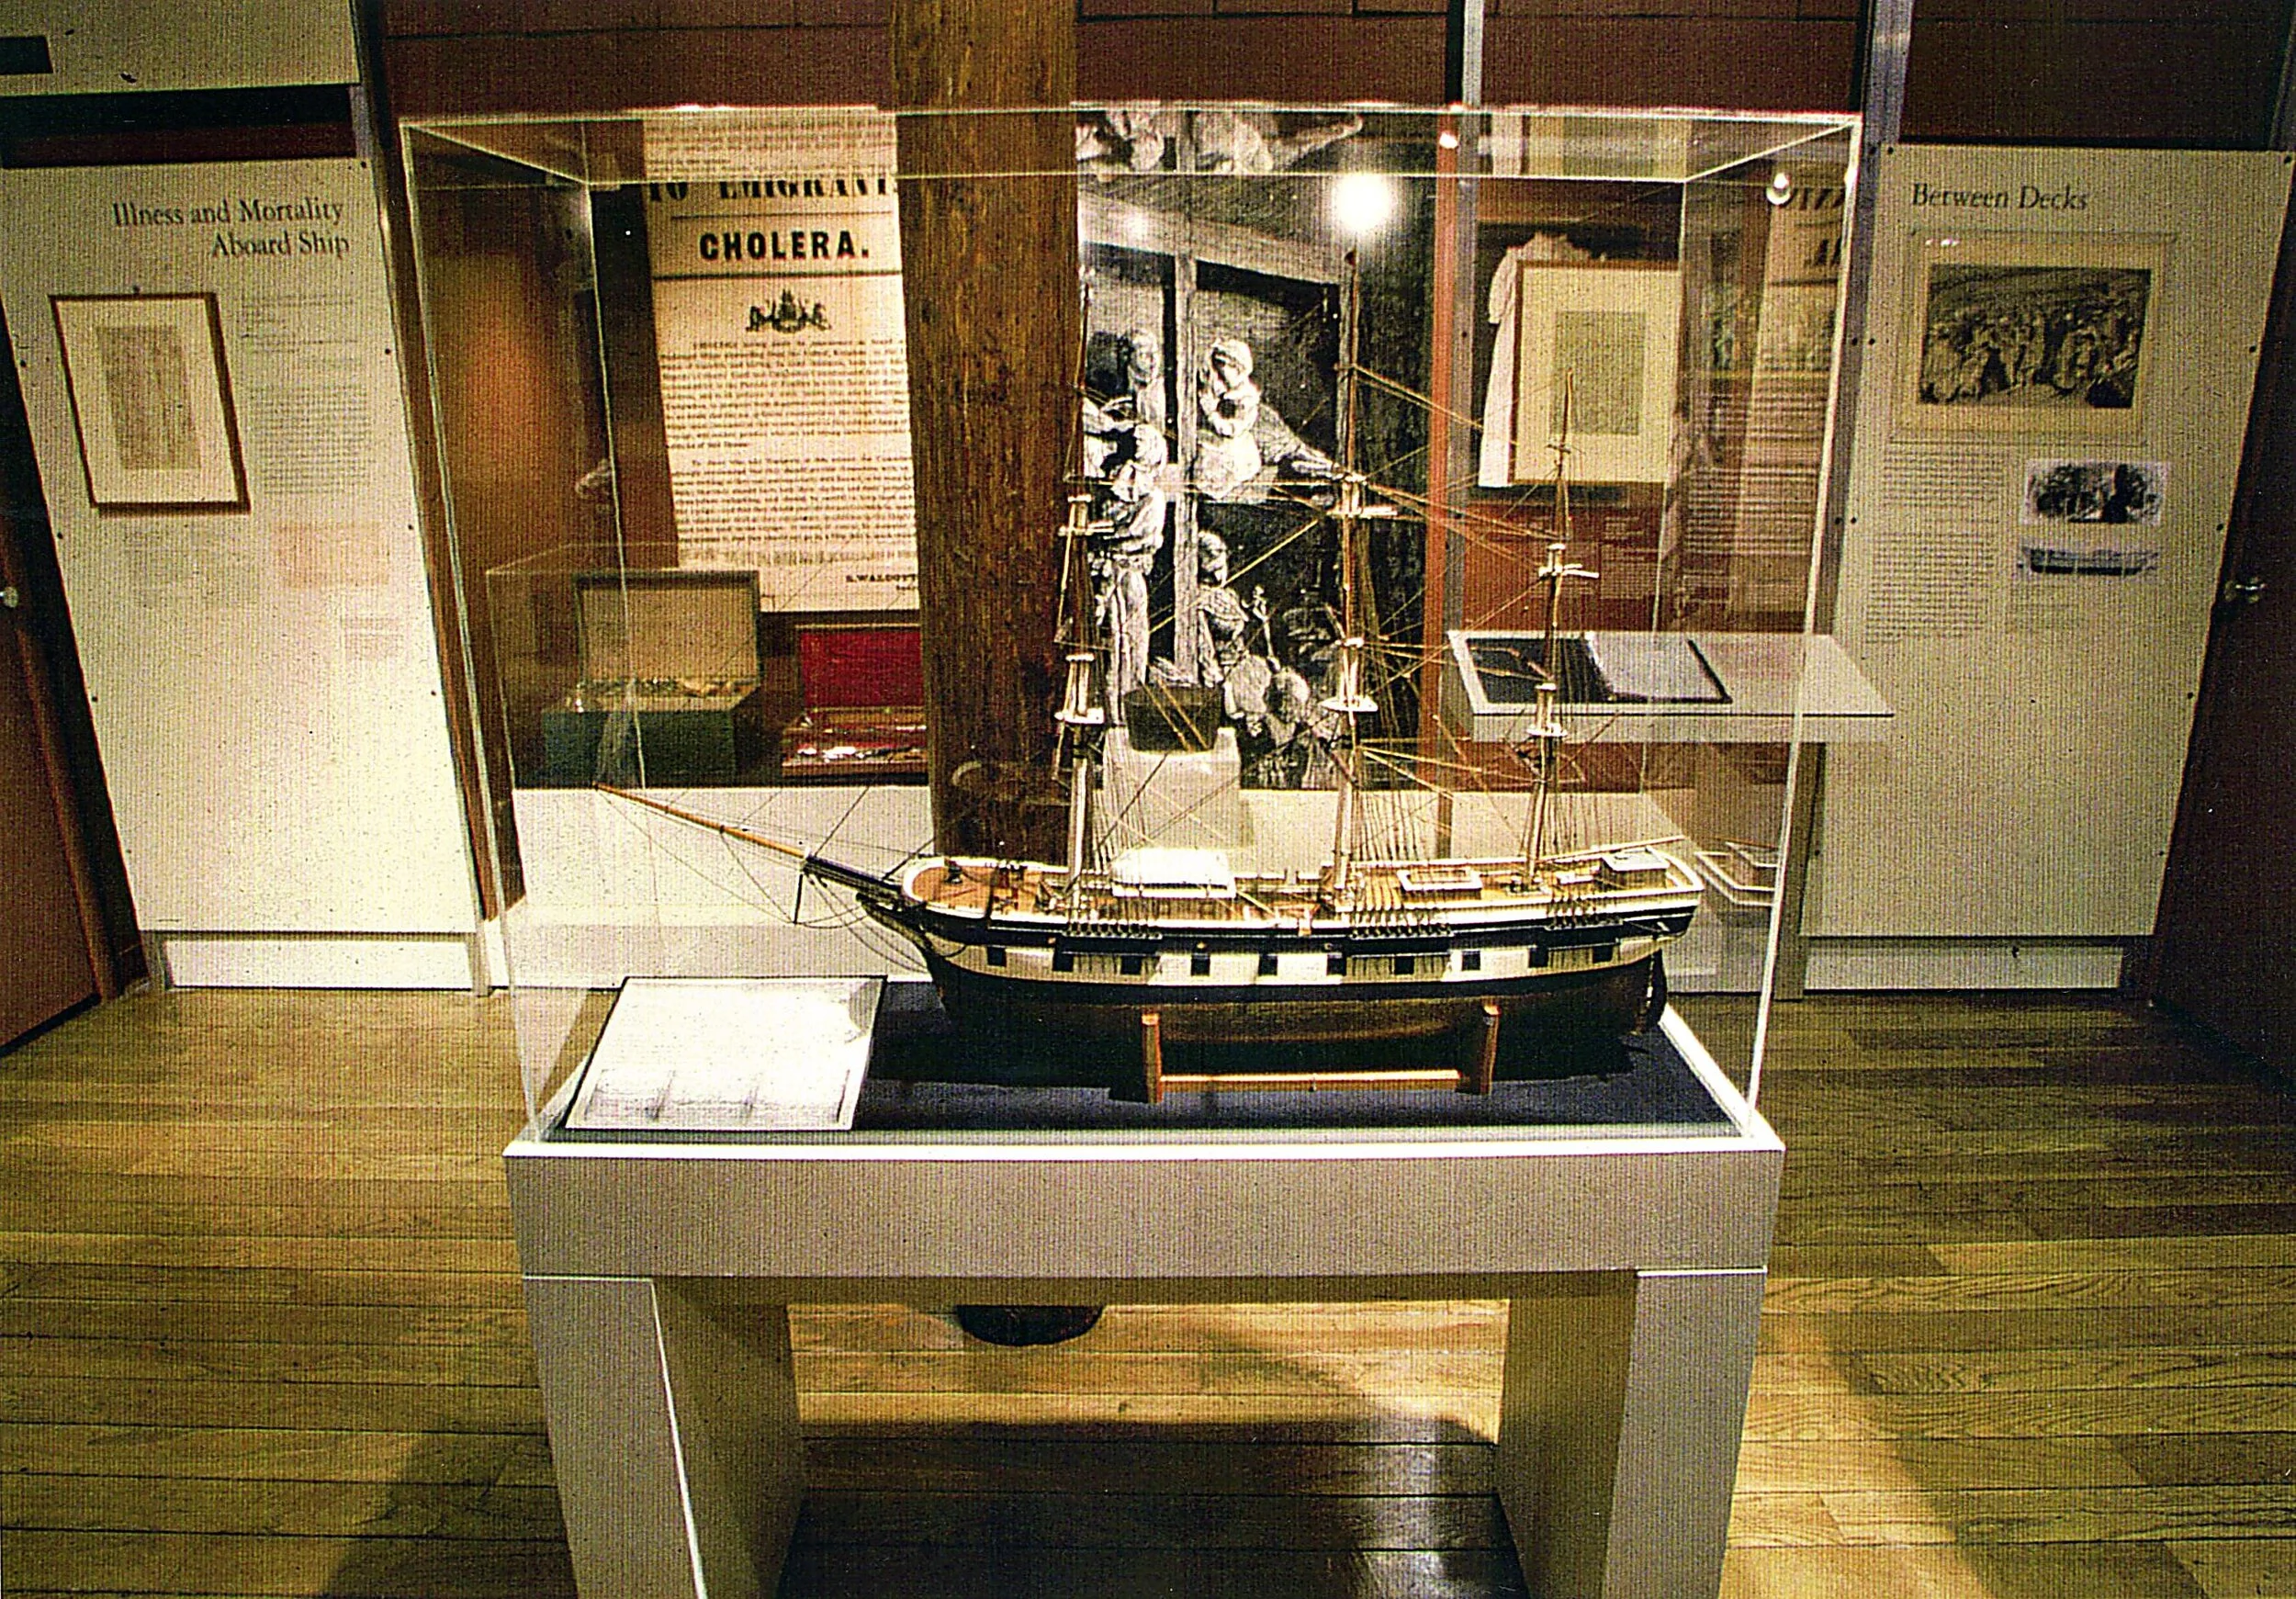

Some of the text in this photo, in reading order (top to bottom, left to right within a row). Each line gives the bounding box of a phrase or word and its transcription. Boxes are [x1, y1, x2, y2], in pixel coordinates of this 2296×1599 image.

[1913, 183, 2088, 209] Between Decks
[112, 197, 344, 227] Illness and Mortality
[211, 229, 350, 258] Aboard Ship
[700, 231, 869, 260] CHOLERA.
